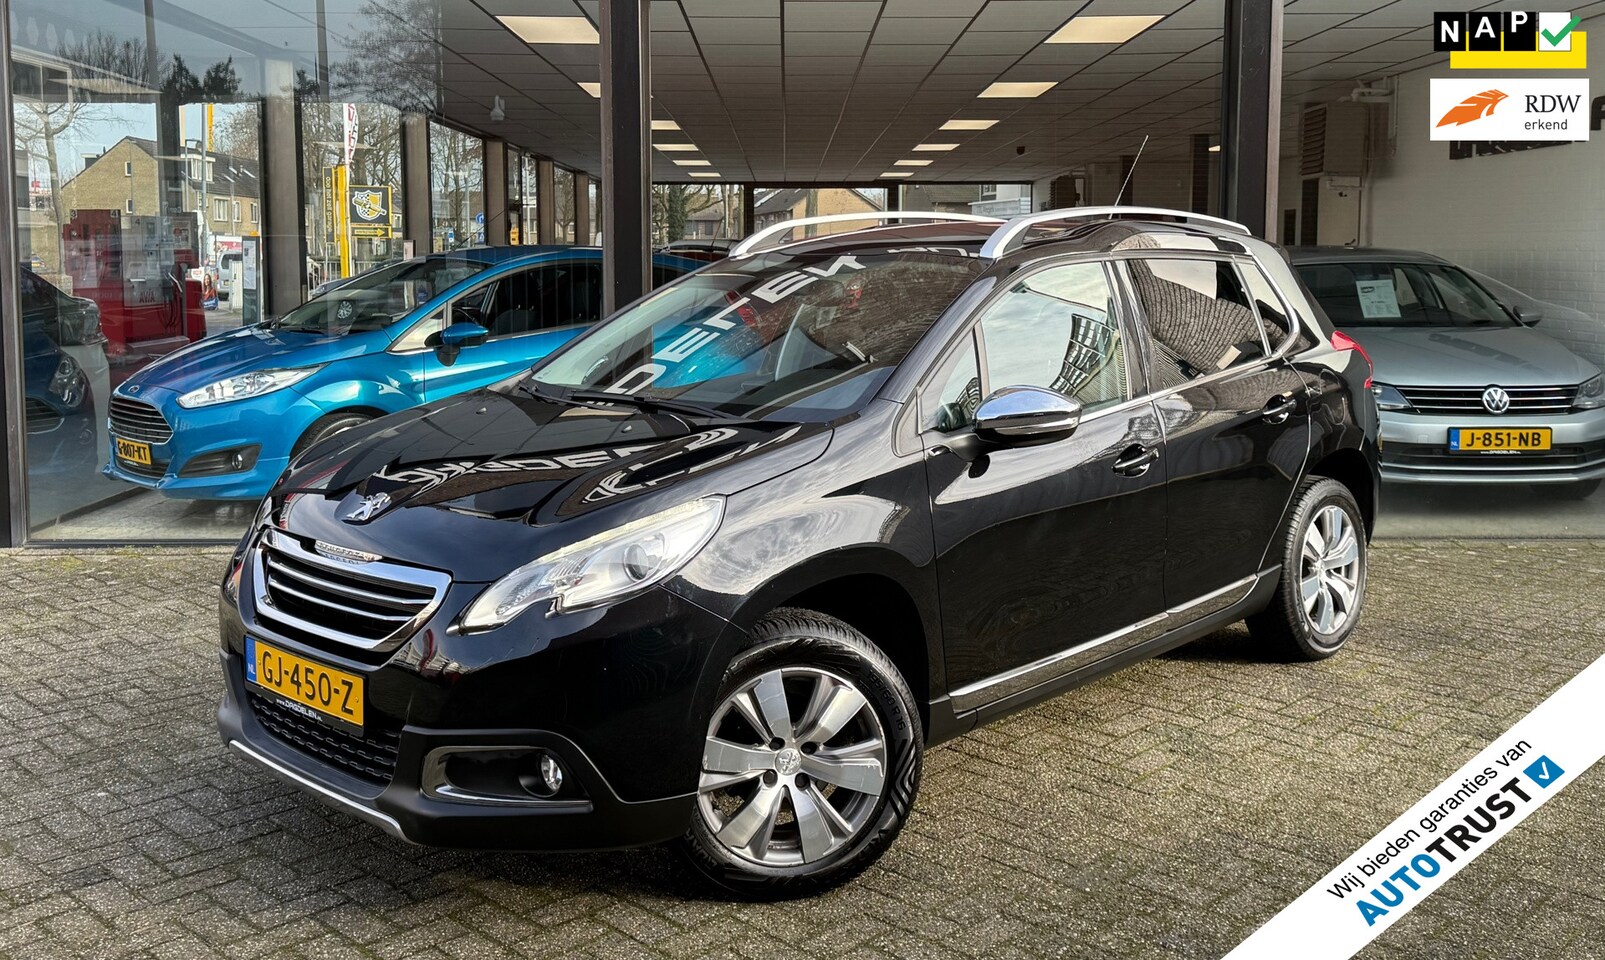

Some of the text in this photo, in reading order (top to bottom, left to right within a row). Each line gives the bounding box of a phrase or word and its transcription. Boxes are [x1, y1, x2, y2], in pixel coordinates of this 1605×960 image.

[1466, 432, 1542, 447] J-851-NB
[247, 662, 256, 675] NL
[262, 651, 354, 716] GJ-450-Z
